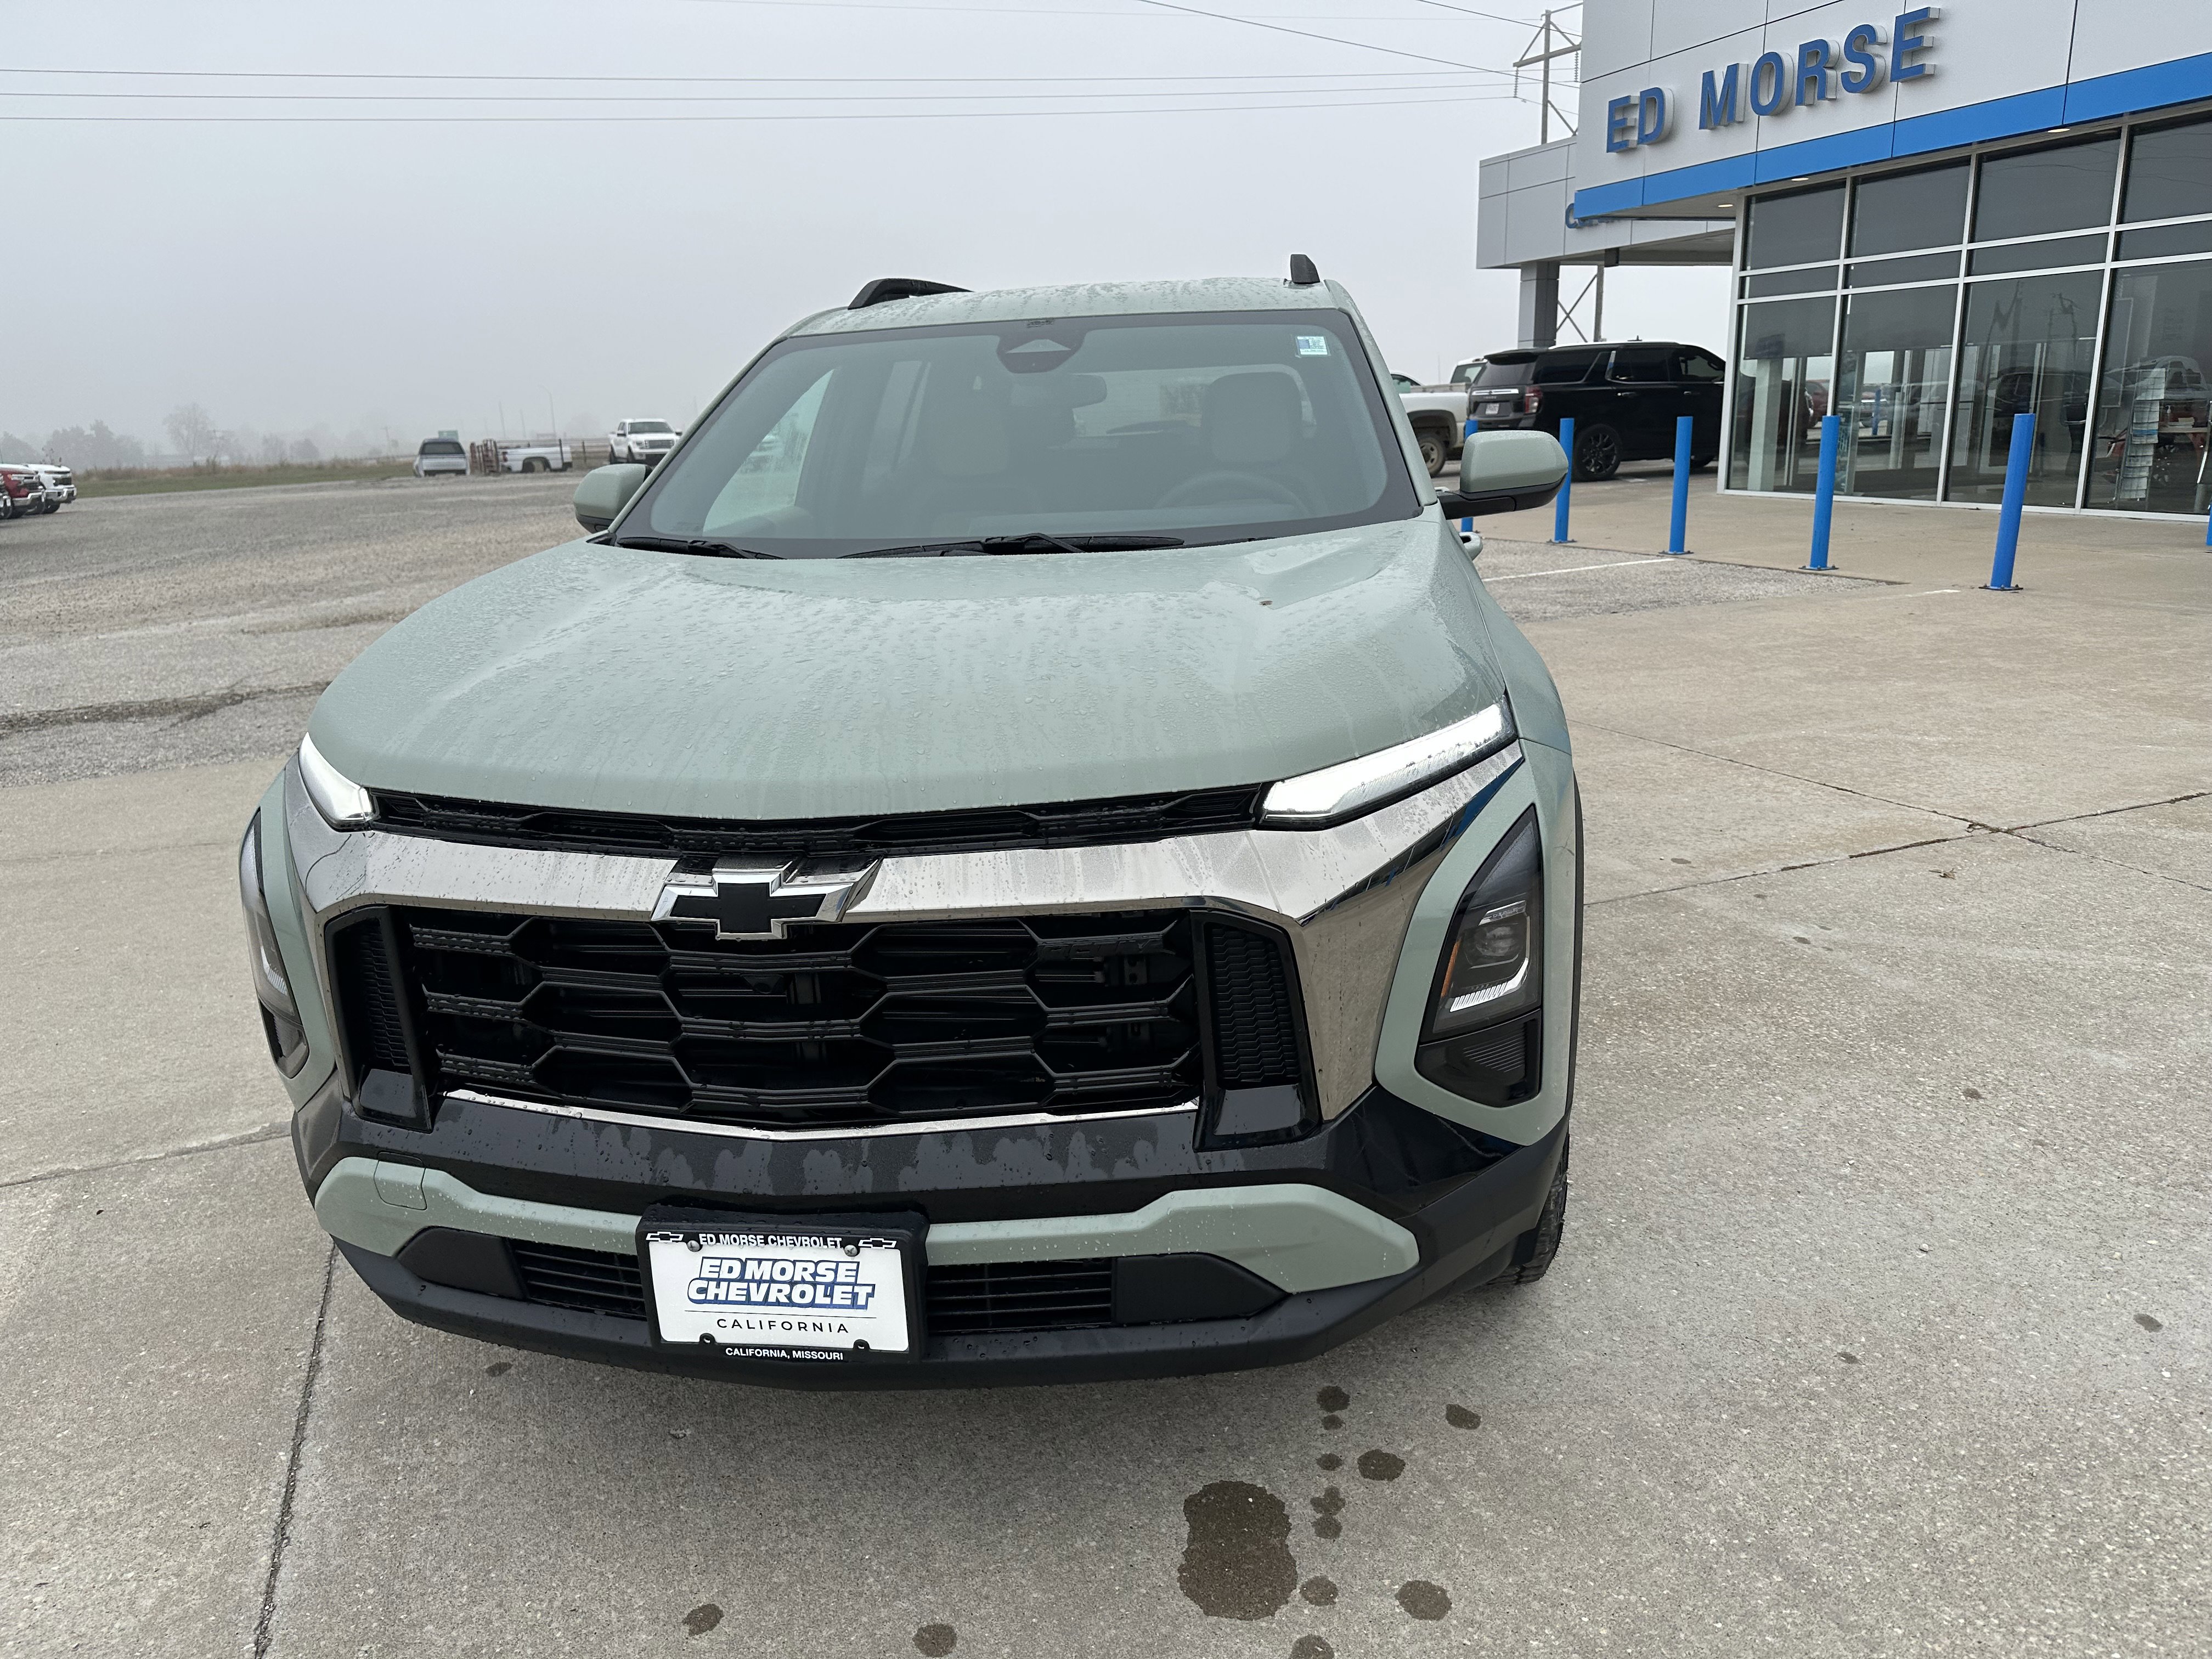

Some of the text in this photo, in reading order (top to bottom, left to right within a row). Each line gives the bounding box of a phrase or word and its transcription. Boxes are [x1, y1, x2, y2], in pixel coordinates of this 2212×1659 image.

[1607, 7, 1939, 153] ED MORSE
[699, 1234, 842, 1248] ED MORSE CHEVROLET
[701, 1257, 858, 1284] ED MORSE
[687, 1279, 876, 1309] CHEVROLET
[717, 1319, 848, 1333] CALIFORNIA
[725, 1347, 843, 1360] CALIFORNIA, MISSOURI
